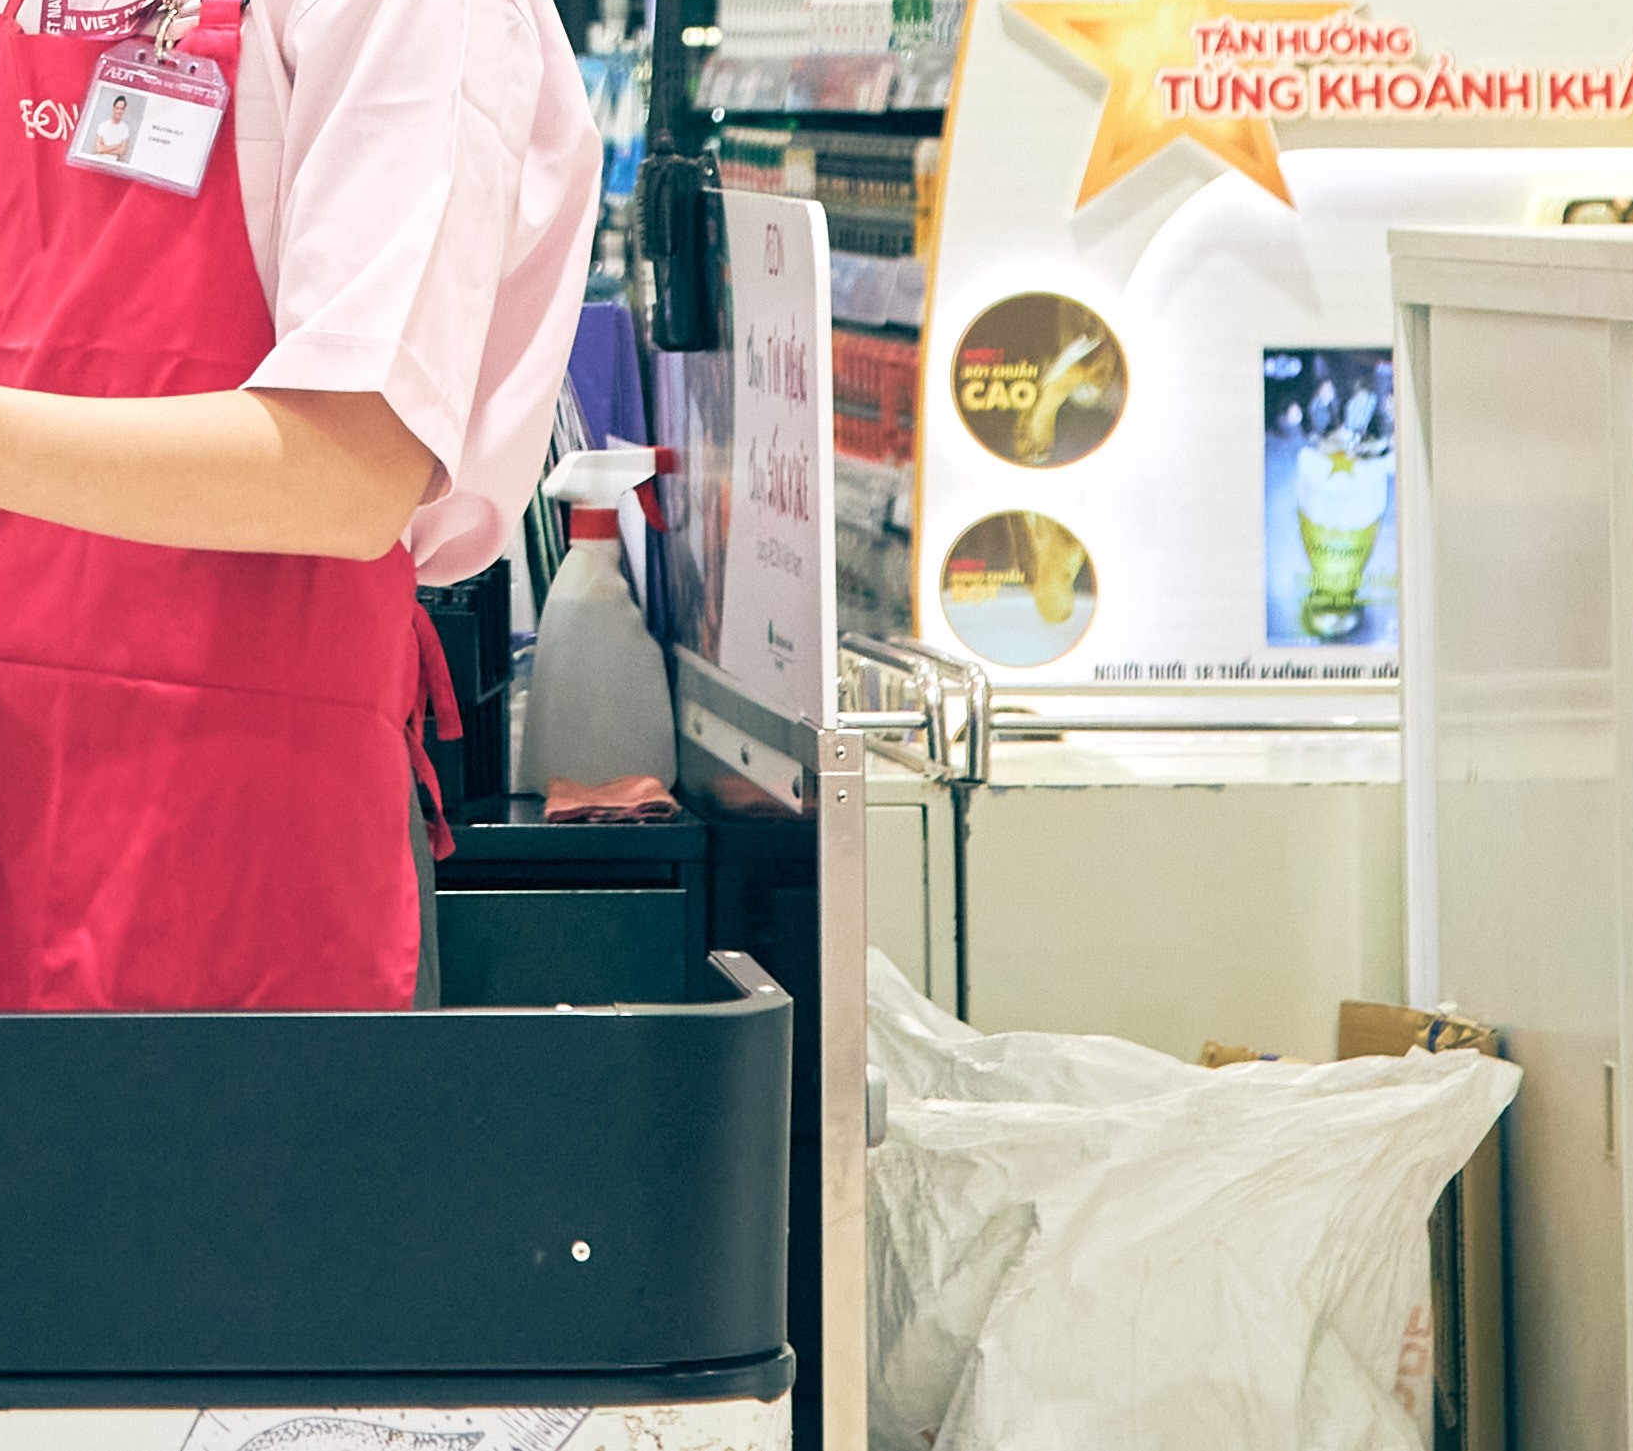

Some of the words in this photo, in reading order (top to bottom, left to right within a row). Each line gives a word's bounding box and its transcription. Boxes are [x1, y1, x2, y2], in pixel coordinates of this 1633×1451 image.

[80, 11, 119, 32] VIET
[1276, 15, 1412, 56] HƯỞNG
[1161, 60, 1302, 113] TỪNG
[1318, 53, 1531, 112] KHOẢNH
[961, 380, 1039, 412] CAO
